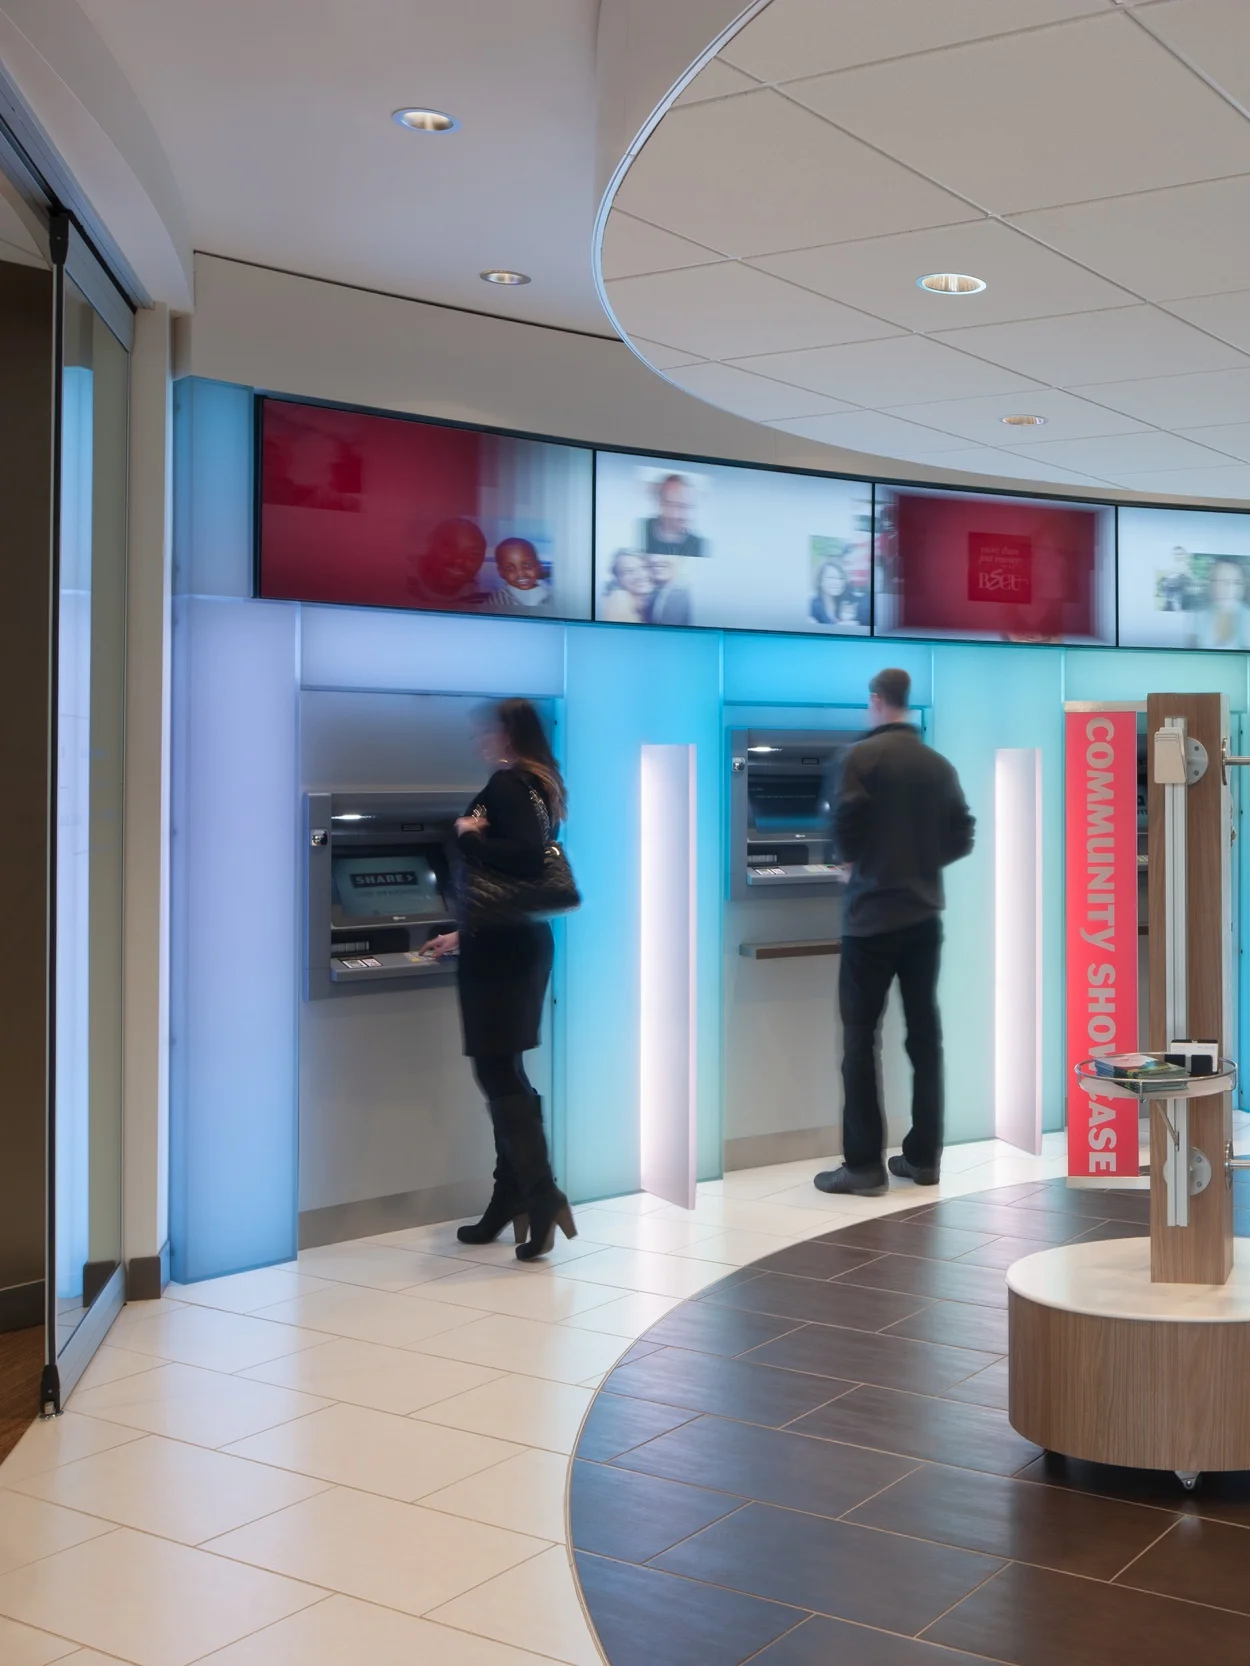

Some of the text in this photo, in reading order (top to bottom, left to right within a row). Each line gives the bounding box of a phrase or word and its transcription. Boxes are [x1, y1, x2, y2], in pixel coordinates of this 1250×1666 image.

[355, 874, 405, 884] SHARE
[1080, 716, 1117, 1173] COMMUNITY SHOASE
